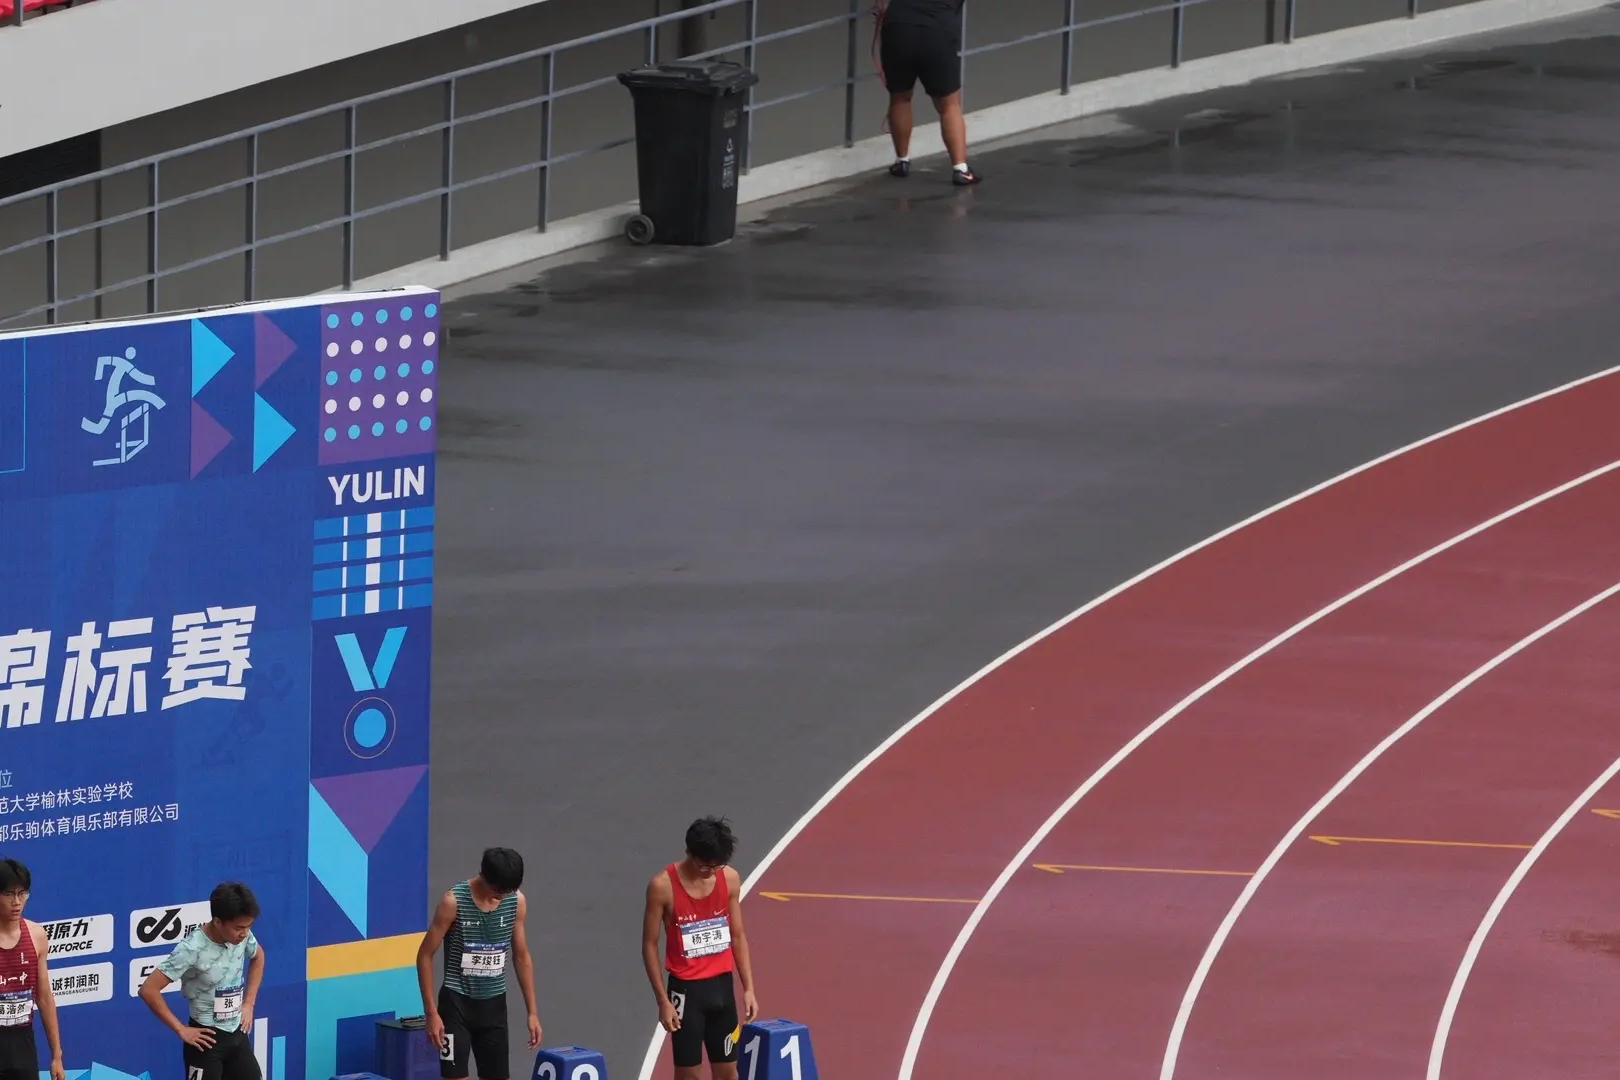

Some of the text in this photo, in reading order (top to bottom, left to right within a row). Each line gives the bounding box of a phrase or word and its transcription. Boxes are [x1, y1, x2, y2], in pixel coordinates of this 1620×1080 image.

[327, 465, 425, 506] YULIN
[52, 973, 99, 990] 诚邦润和
